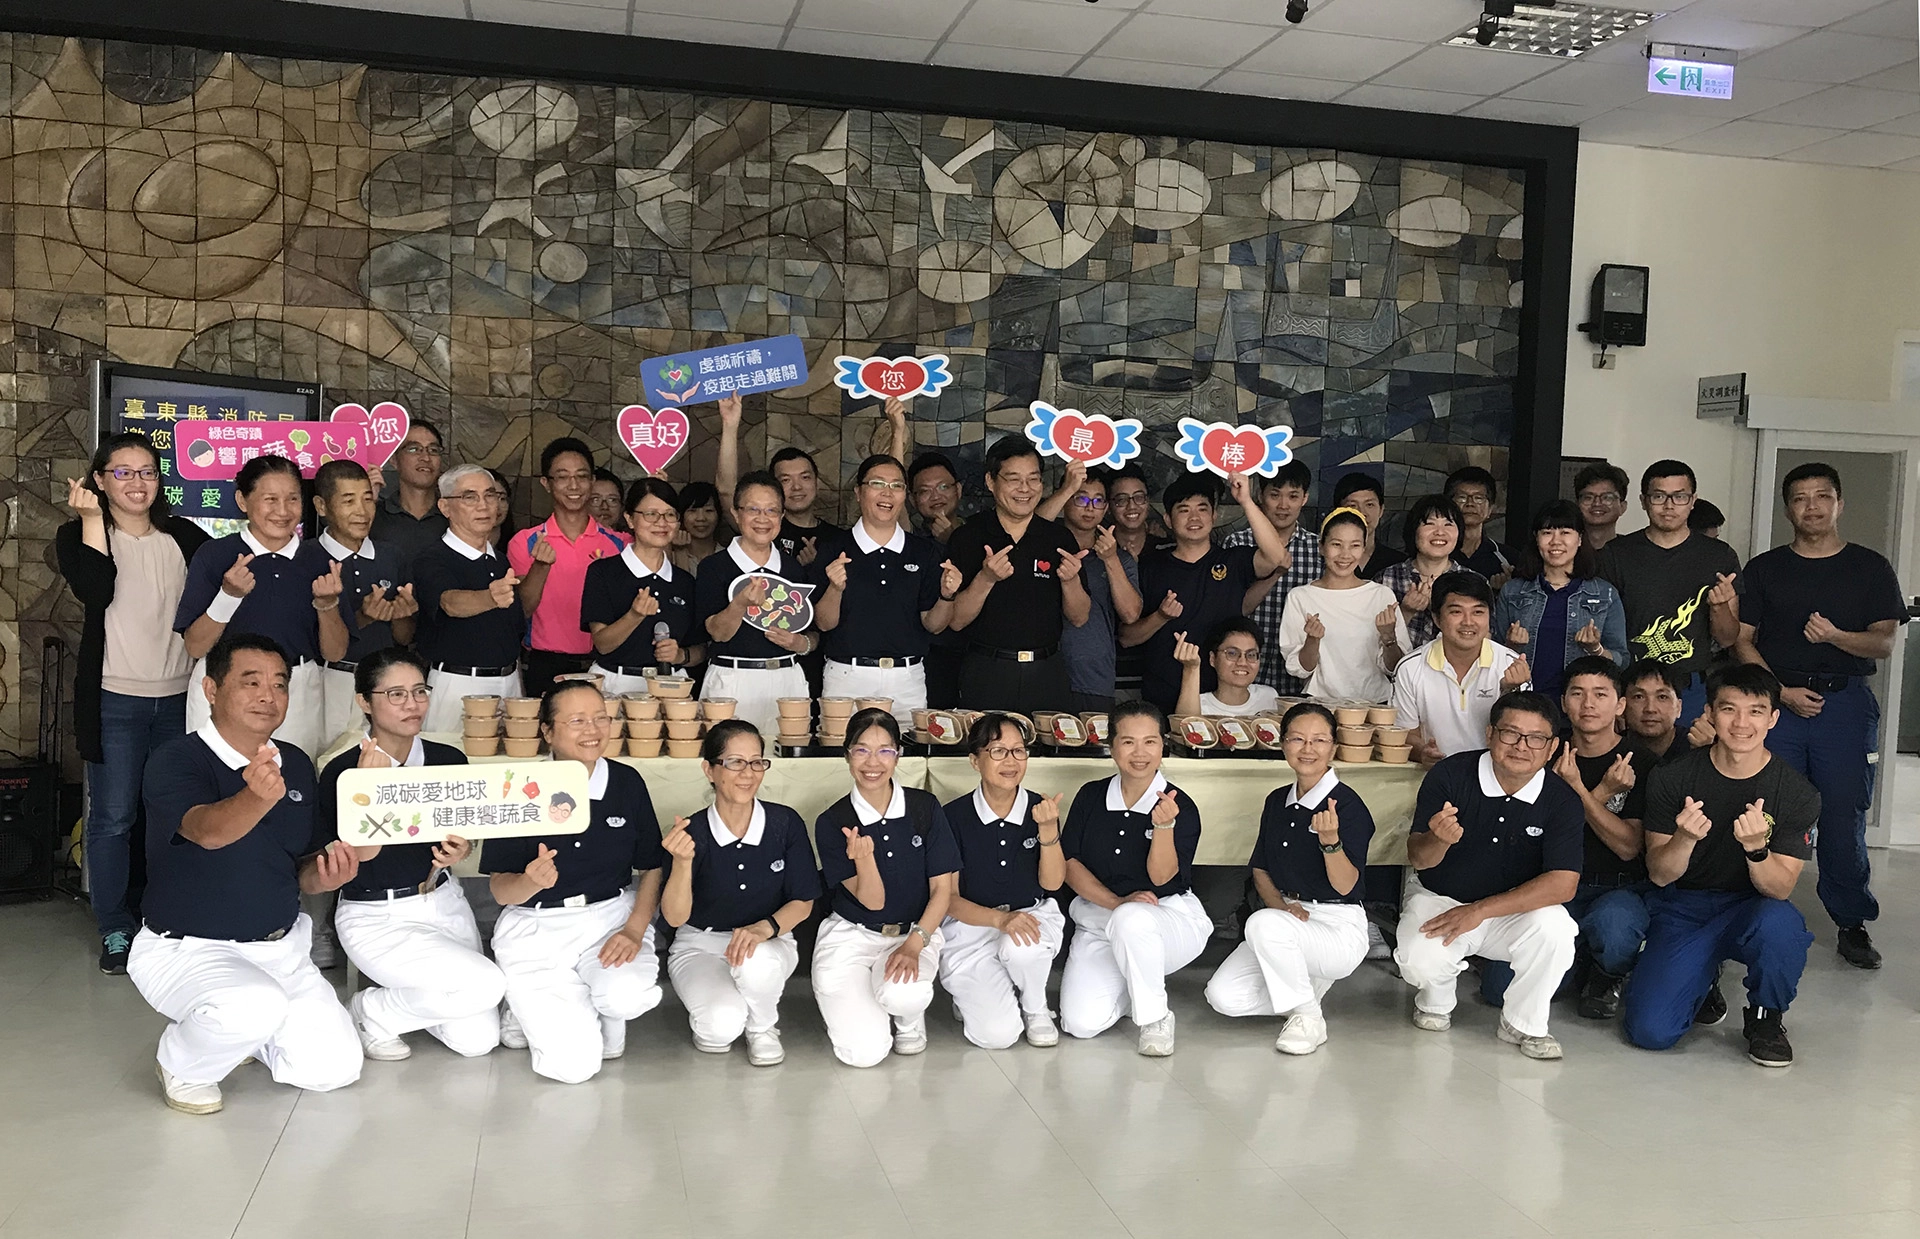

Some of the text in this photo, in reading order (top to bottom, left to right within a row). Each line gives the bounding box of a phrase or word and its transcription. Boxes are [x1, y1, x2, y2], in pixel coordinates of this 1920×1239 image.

[703, 363, 798, 396] 疫起走過難關
[880, 369, 906, 390] 您
[208, 426, 263, 441] 綠色奇蹟
[629, 421, 681, 448] 真好
[1068, 427, 1095, 455] 最
[1220, 441, 1245, 468] 棒
[1034, 559, 1038, 572] I
[376, 780, 488, 805] 減碳愛地球
[432, 803, 541, 828] 健康饗蔬食
